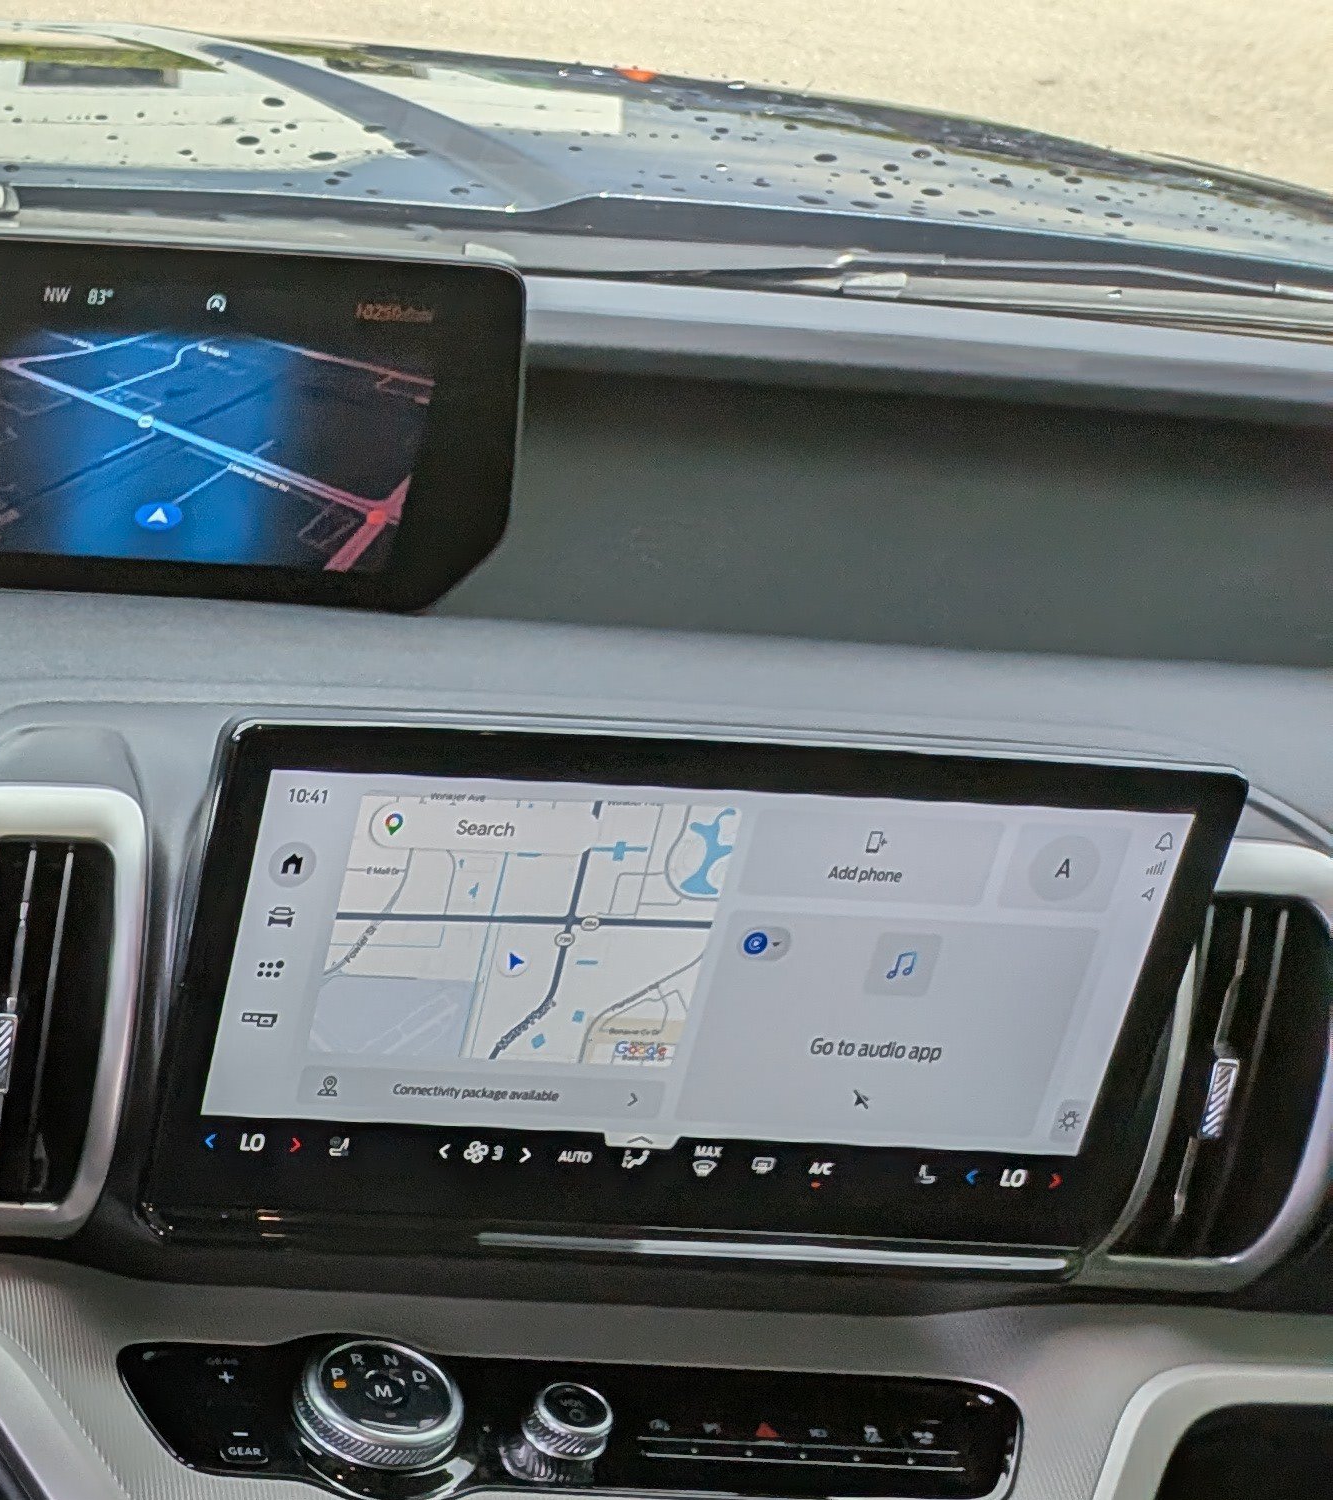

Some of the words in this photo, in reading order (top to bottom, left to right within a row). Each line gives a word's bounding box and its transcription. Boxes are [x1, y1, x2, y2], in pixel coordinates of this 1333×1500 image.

[44, 286, 71, 302] NW
[288, 788, 329, 804] 10:41
[455, 819, 516, 838] Search
[827, 866, 858, 881] Add
[857, 867, 902, 883] phone
[1054, 857, 1071, 879] A
[614, 1040, 668, 1061] Google
[810, 1037, 834, 1056] Go
[837, 1038, 855, 1056] to
[857, 1040, 906, 1059] audio
[908, 1045, 942, 1062] app
[392, 1083, 461, 1099] Connectivity
[461, 1086, 508, 1101] package
[508, 1089, 560, 1102] available
[239, 1134, 265, 1152] LO
[491, 1145, 504, 1161] 3
[557, 1150, 593, 1163] AUTO
[694, 1145, 723, 1158] MAX
[808, 1161, 836, 1176] A/C
[999, 1168, 1027, 1187] LO
[351, 1353, 365, 1366] R
[384, 1354, 399, 1367] N
[331, 1367, 344, 1380] P
[412, 1369, 427, 1383] D
[374, 1384, 392, 1399] M
[227, 1446, 261, 1457] GEAR
